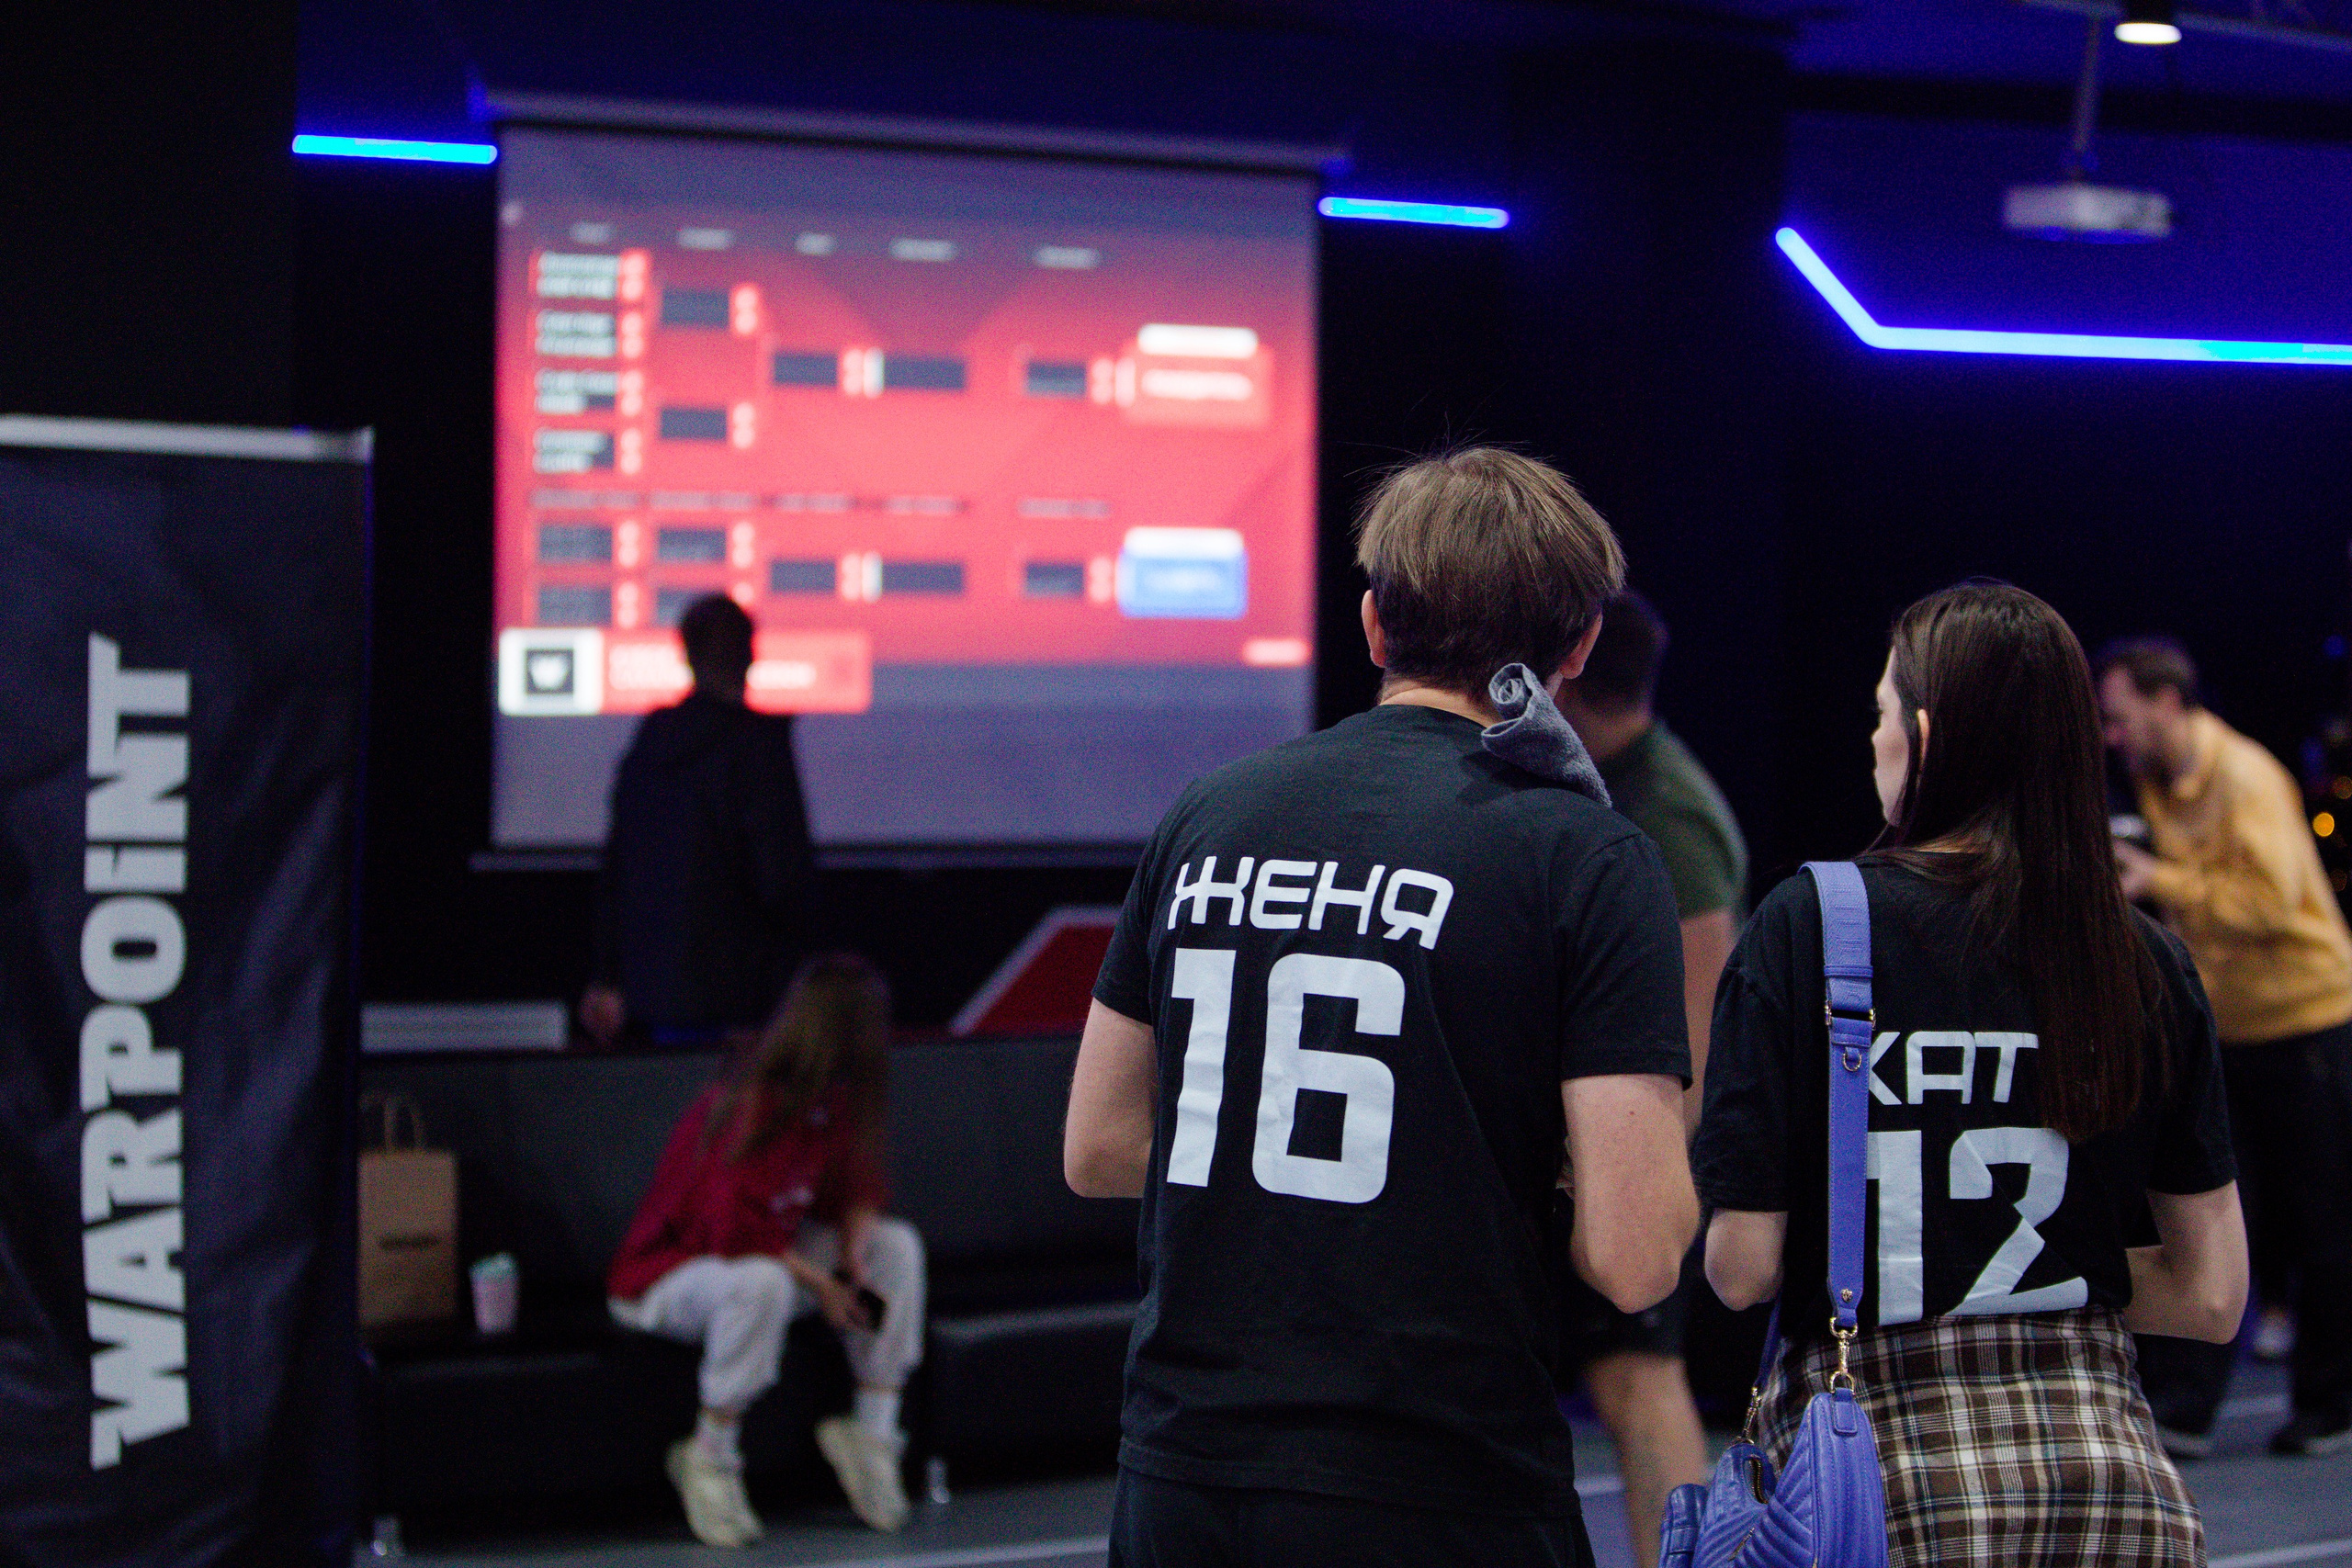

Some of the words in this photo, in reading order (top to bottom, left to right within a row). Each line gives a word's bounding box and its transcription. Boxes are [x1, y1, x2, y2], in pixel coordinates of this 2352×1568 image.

[1167, 855, 1454, 950] ЖЕНЯ
[1166, 947, 1406, 1203] 16
[1867, 1030, 2040, 1105] КАТ
[1865, 1126, 2088, 1325] 12
